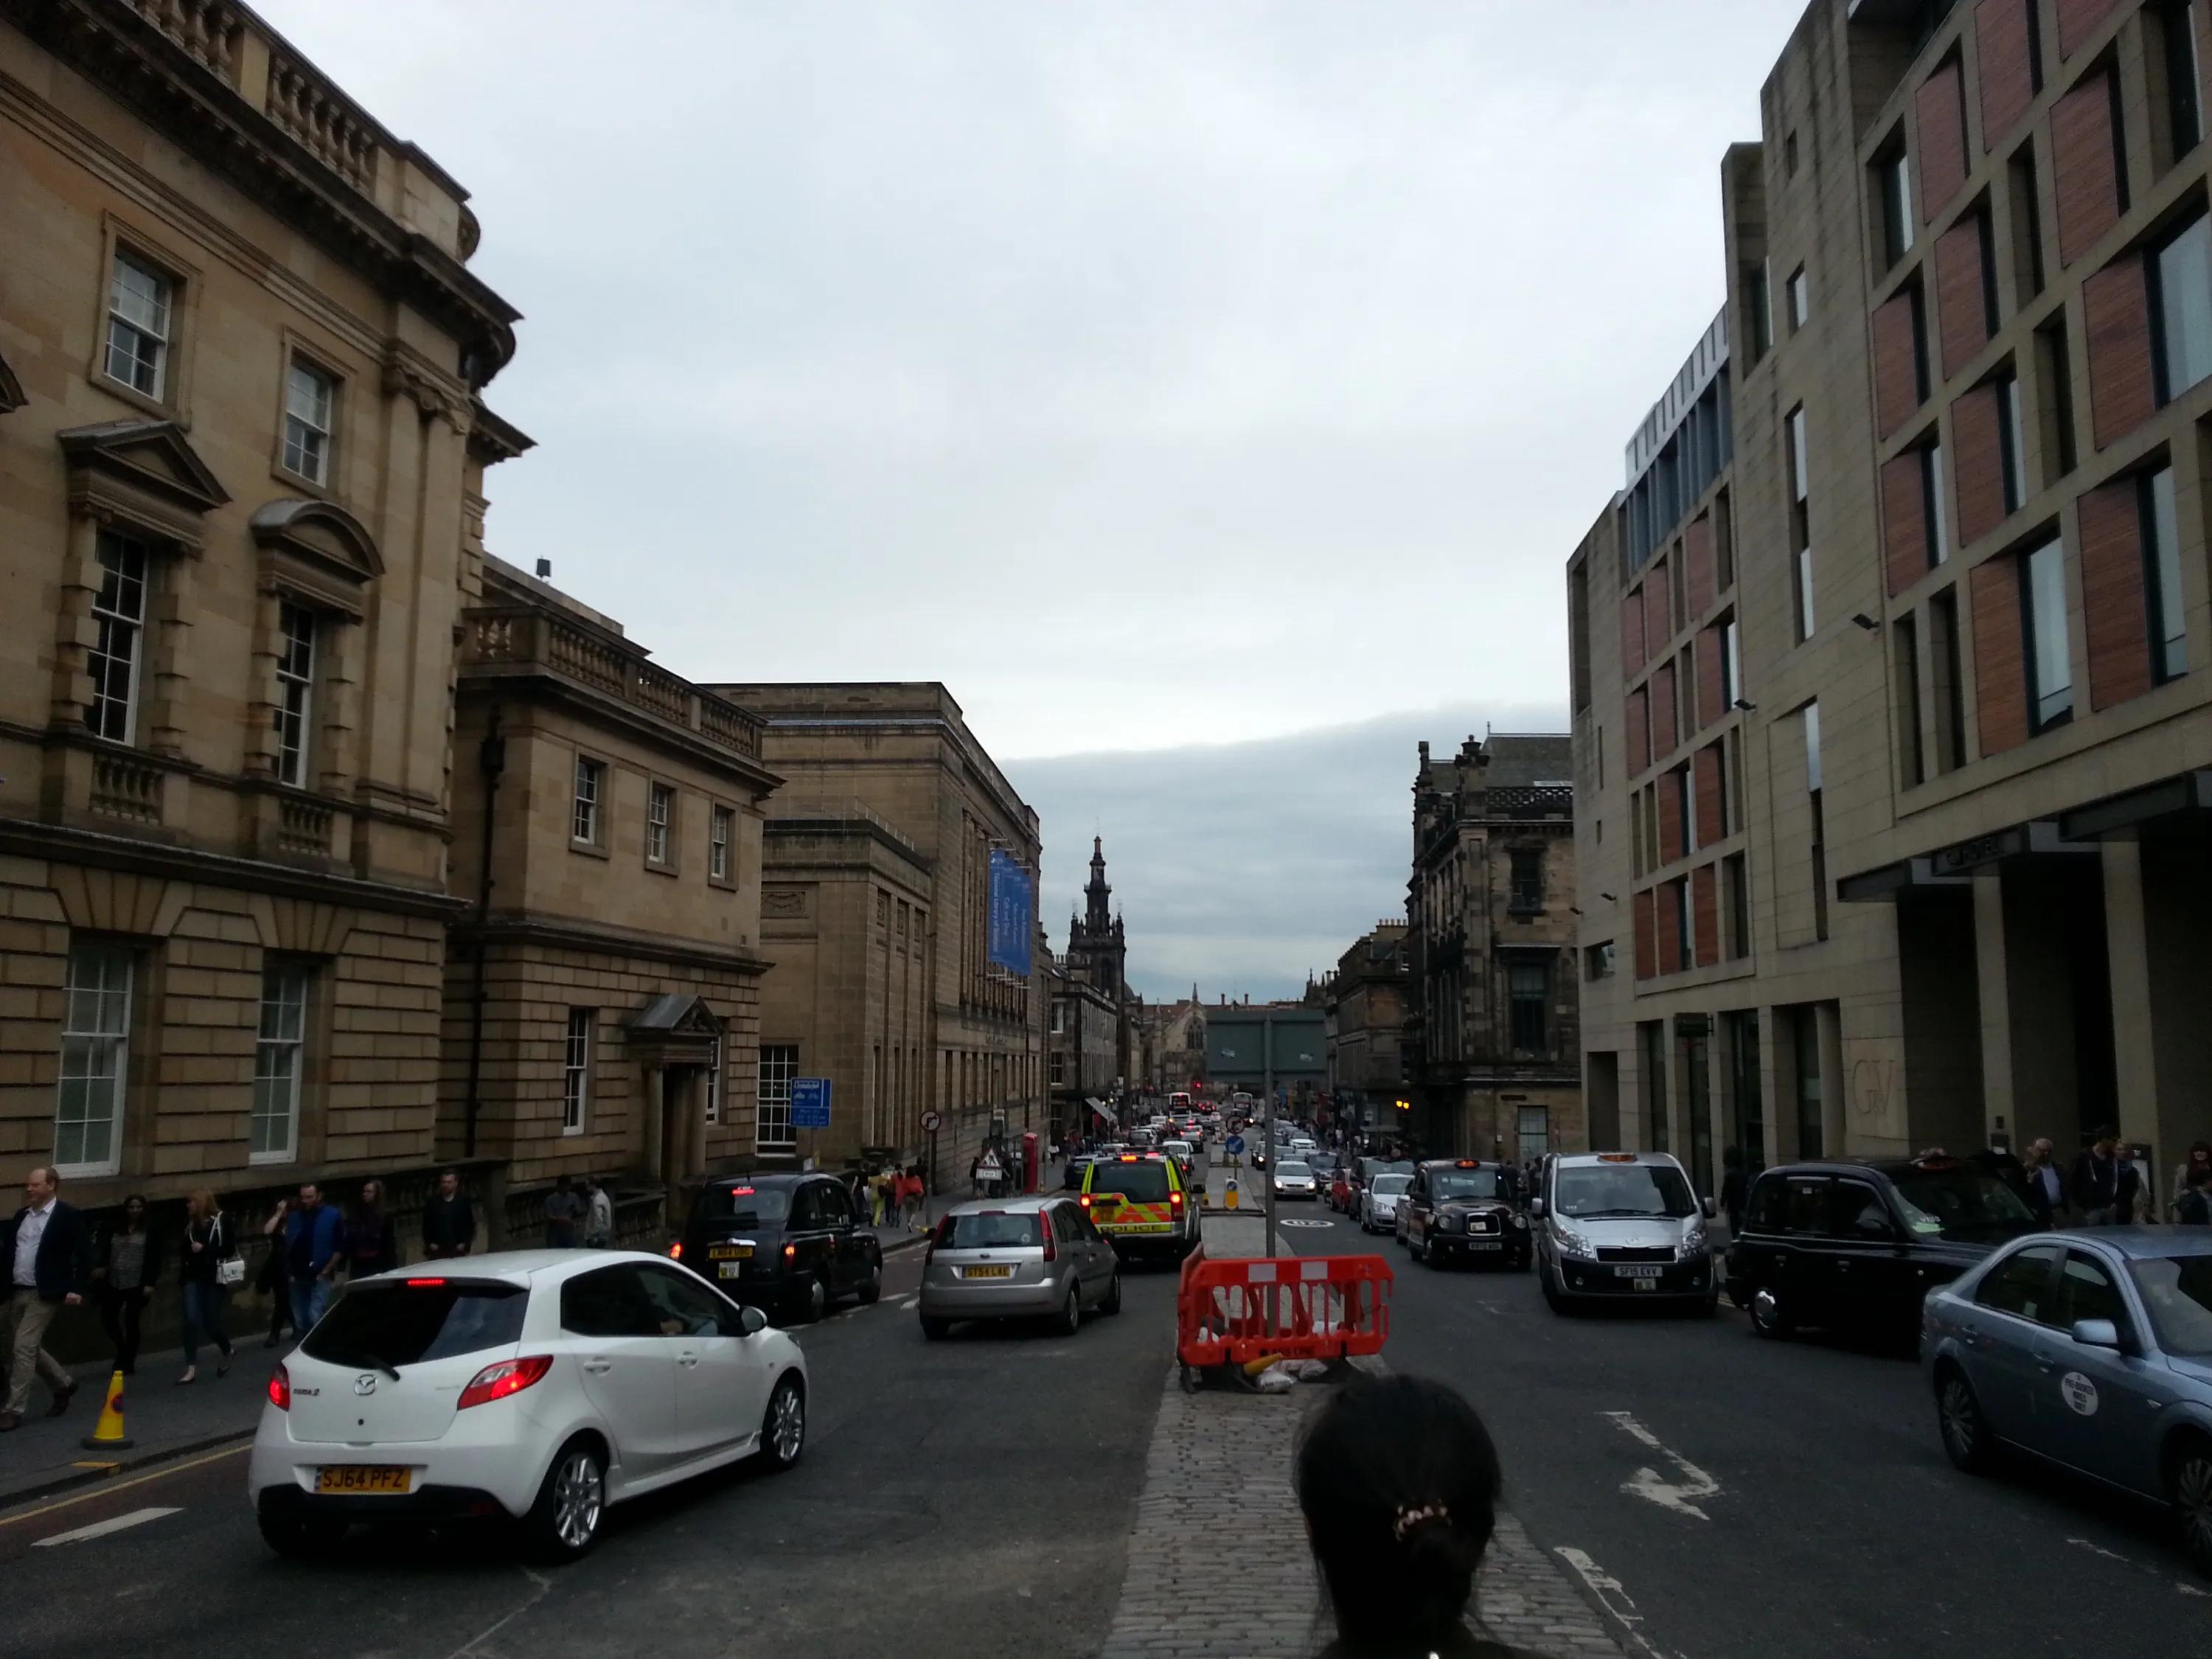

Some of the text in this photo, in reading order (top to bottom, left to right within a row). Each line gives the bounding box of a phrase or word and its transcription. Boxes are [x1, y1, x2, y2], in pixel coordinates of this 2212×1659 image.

[992, 898, 1000, 919] Library
[1099, 1225, 1162, 1234] POLICE
[323, 1468, 405, 1488] SJ64 PFZ
